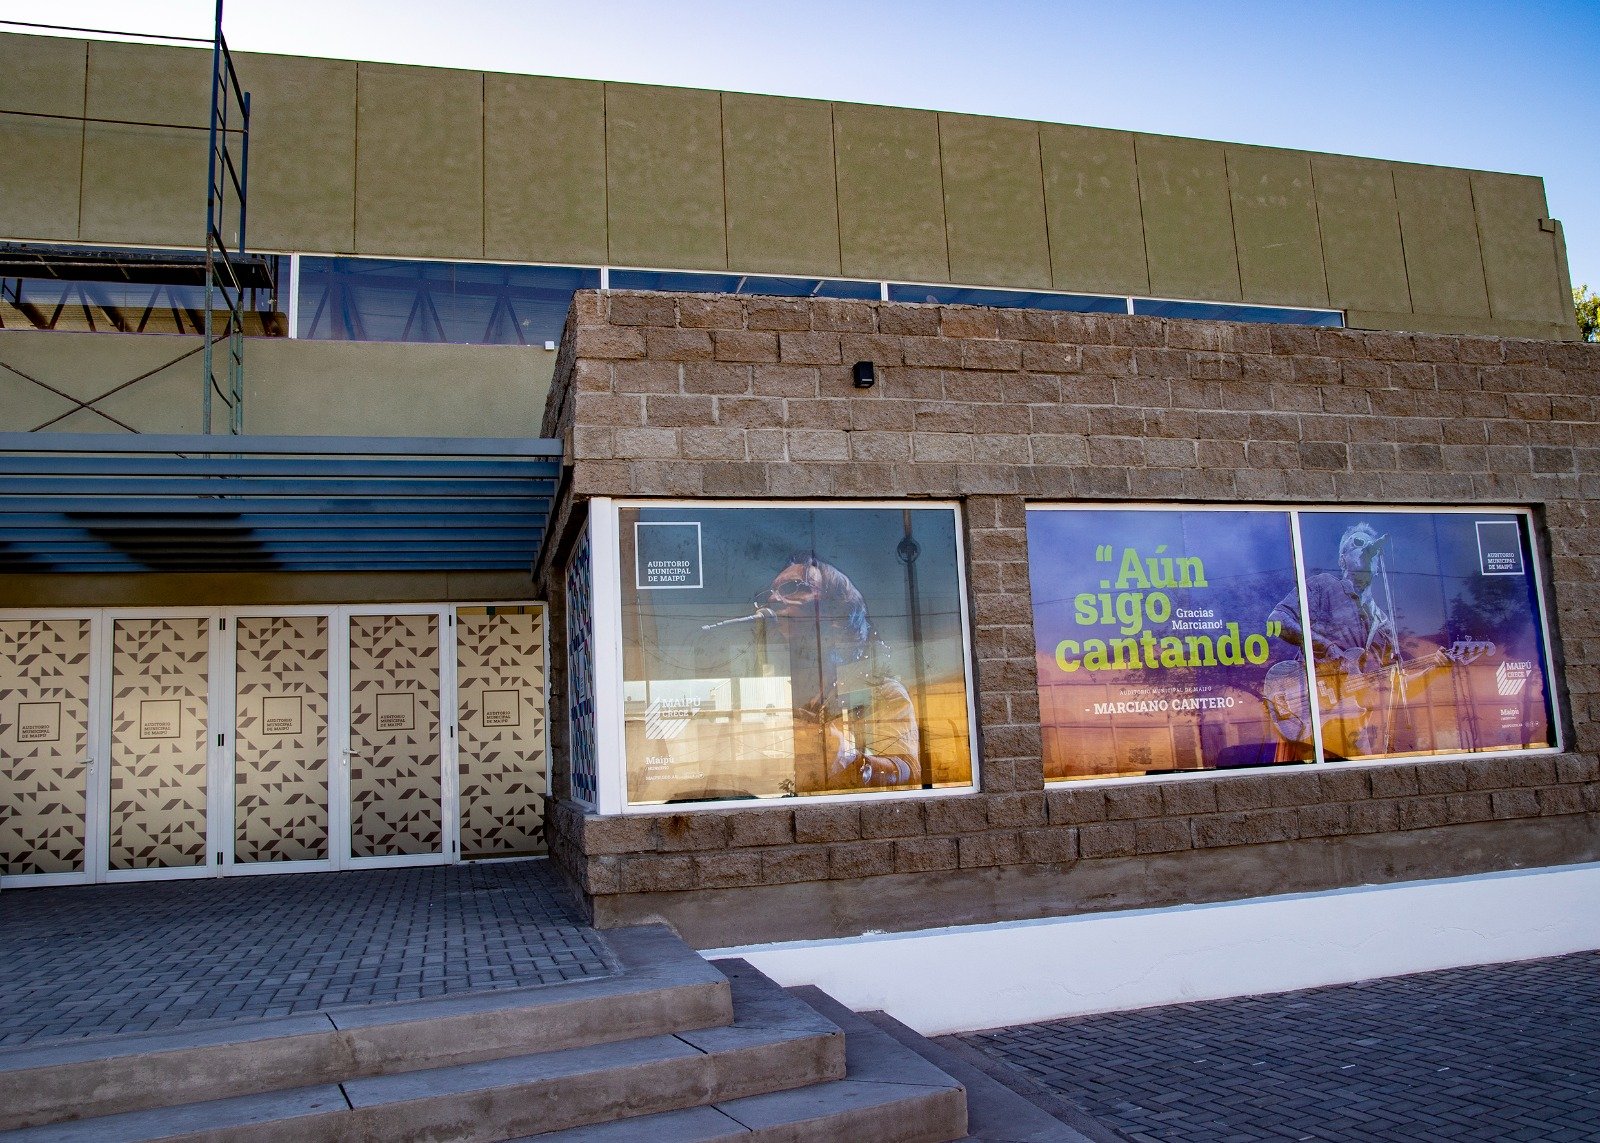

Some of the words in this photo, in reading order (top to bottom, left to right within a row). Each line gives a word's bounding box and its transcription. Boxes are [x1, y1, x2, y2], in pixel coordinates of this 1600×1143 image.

[1074, 580, 1171, 635] sigo
[1176, 608, 1213, 618] Gracias
[1172, 619, 1223, 630] Marciano!
[1506, 660, 1531, 670] MAIPÚ
[662, 696, 701, 708] MAIPÚ
[1094, 700, 1168, 715] MARCIANO
[1172, 697, 1235, 711] CANTERO
[662, 709, 689, 717] CRECE
[646, 755, 674, 765] Maipú
